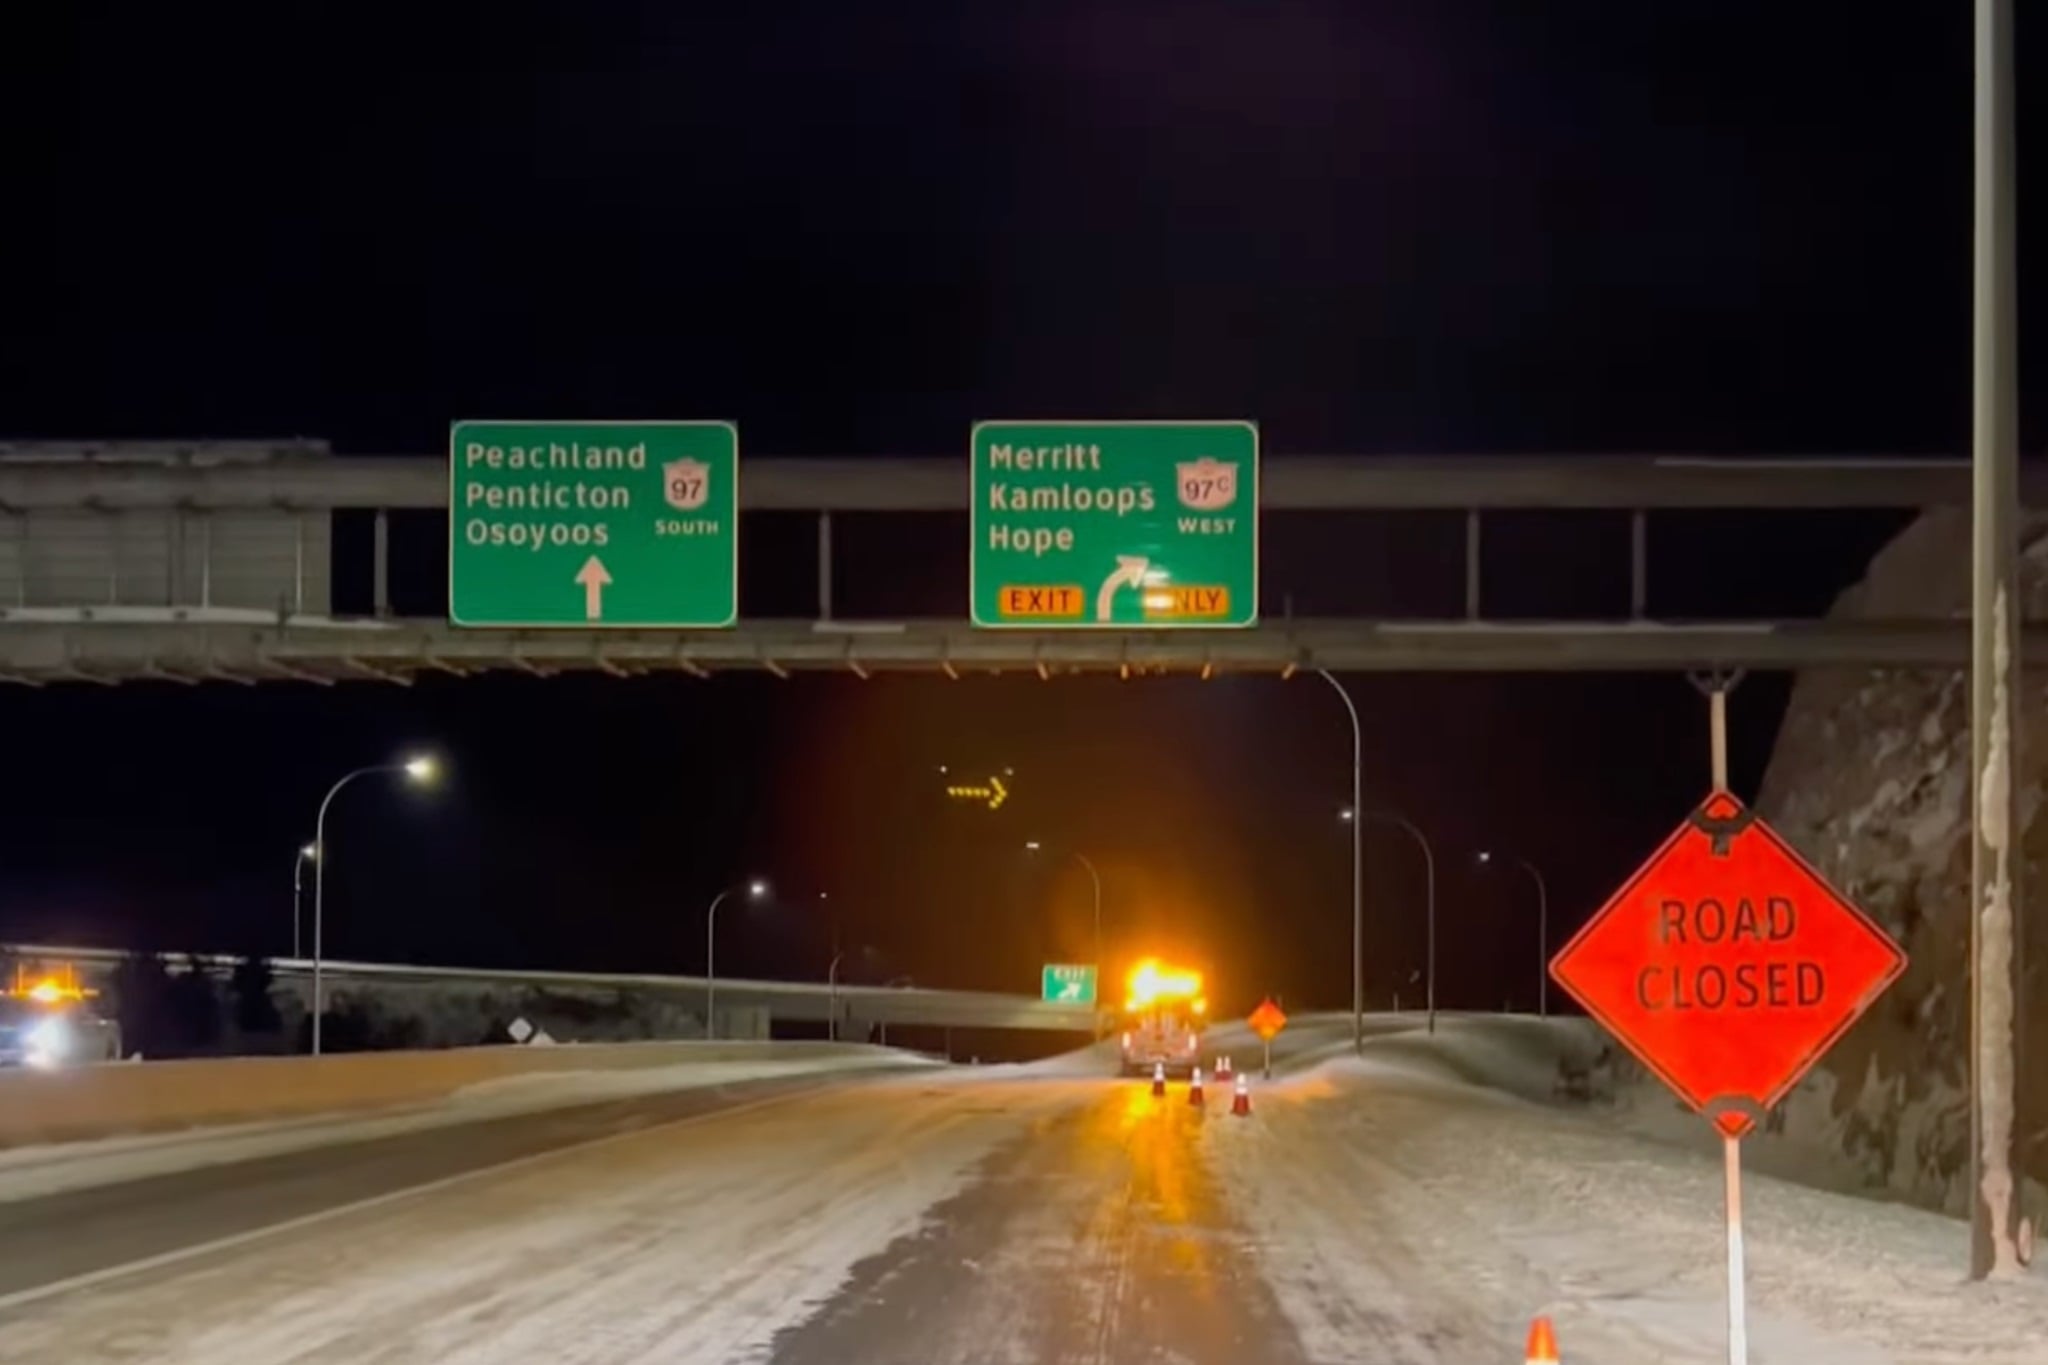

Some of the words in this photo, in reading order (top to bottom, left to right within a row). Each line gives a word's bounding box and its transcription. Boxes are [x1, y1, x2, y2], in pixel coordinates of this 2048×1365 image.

[466, 442, 646, 469] Peachland
[990, 444, 1101, 470] Merritt
[466, 481, 629, 508] Penticton
[671, 478, 702, 500] 97
[990, 483, 1155, 517] Kamloops
[466, 519, 609, 551] Osoyoos
[655, 520, 718, 536] SOUTH
[1178, 518, 1236, 534] WEST
[990, 524, 1074, 557] Hope
[1010, 590, 1072, 612] EXIT
[1156, 590, 1222, 612] NLY
[1660, 896, 1796, 944] ROAD
[1637, 961, 1825, 1010] CLOSED
